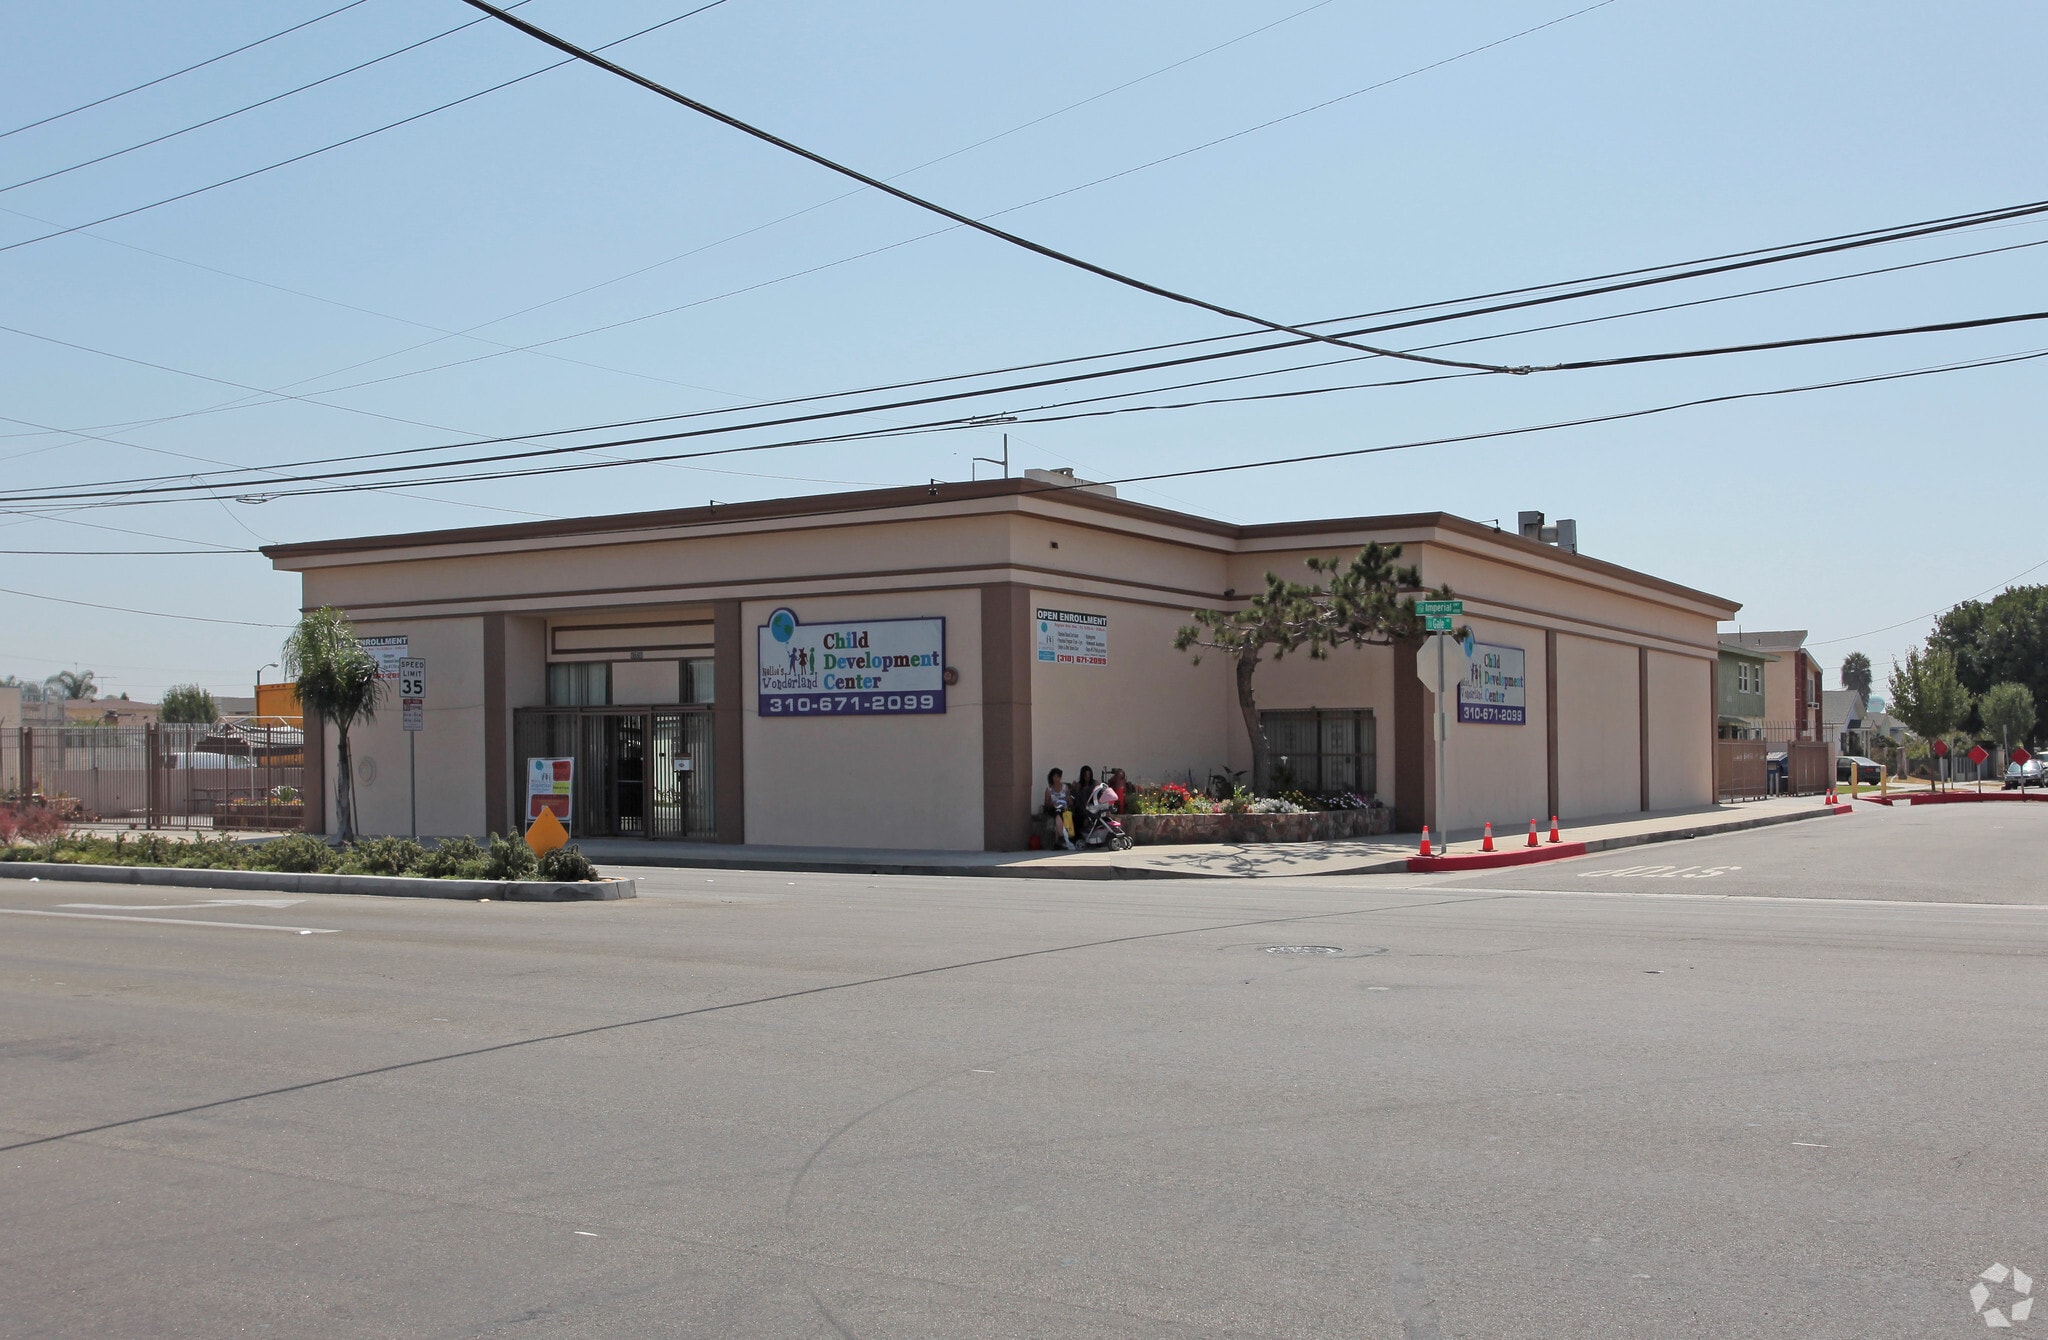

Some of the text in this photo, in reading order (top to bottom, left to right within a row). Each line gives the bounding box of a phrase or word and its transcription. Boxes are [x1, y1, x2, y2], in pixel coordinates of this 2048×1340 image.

[1425, 603, 1452, 613] Imperial
[1037, 610, 1107, 626] OPEN ENROLLMENT
[1432, 618, 1444, 629] Gale
[823, 631, 869, 650] Child
[823, 651, 940, 673] Development
[1057, 653, 1075, 664] (310)
[1076, 655, 1107, 665] 671-2099
[1483, 653, 1501, 669] Child
[402, 679, 423, 695] 35
[762, 671, 818, 691] Wonderland
[823, 673, 882, 691] Center
[1484, 671, 1524, 690] Development
[1484, 688, 1505, 703] Center
[769, 695, 934, 713] 310-671-2099
[1463, 706, 1523, 722] 310-671-2099
